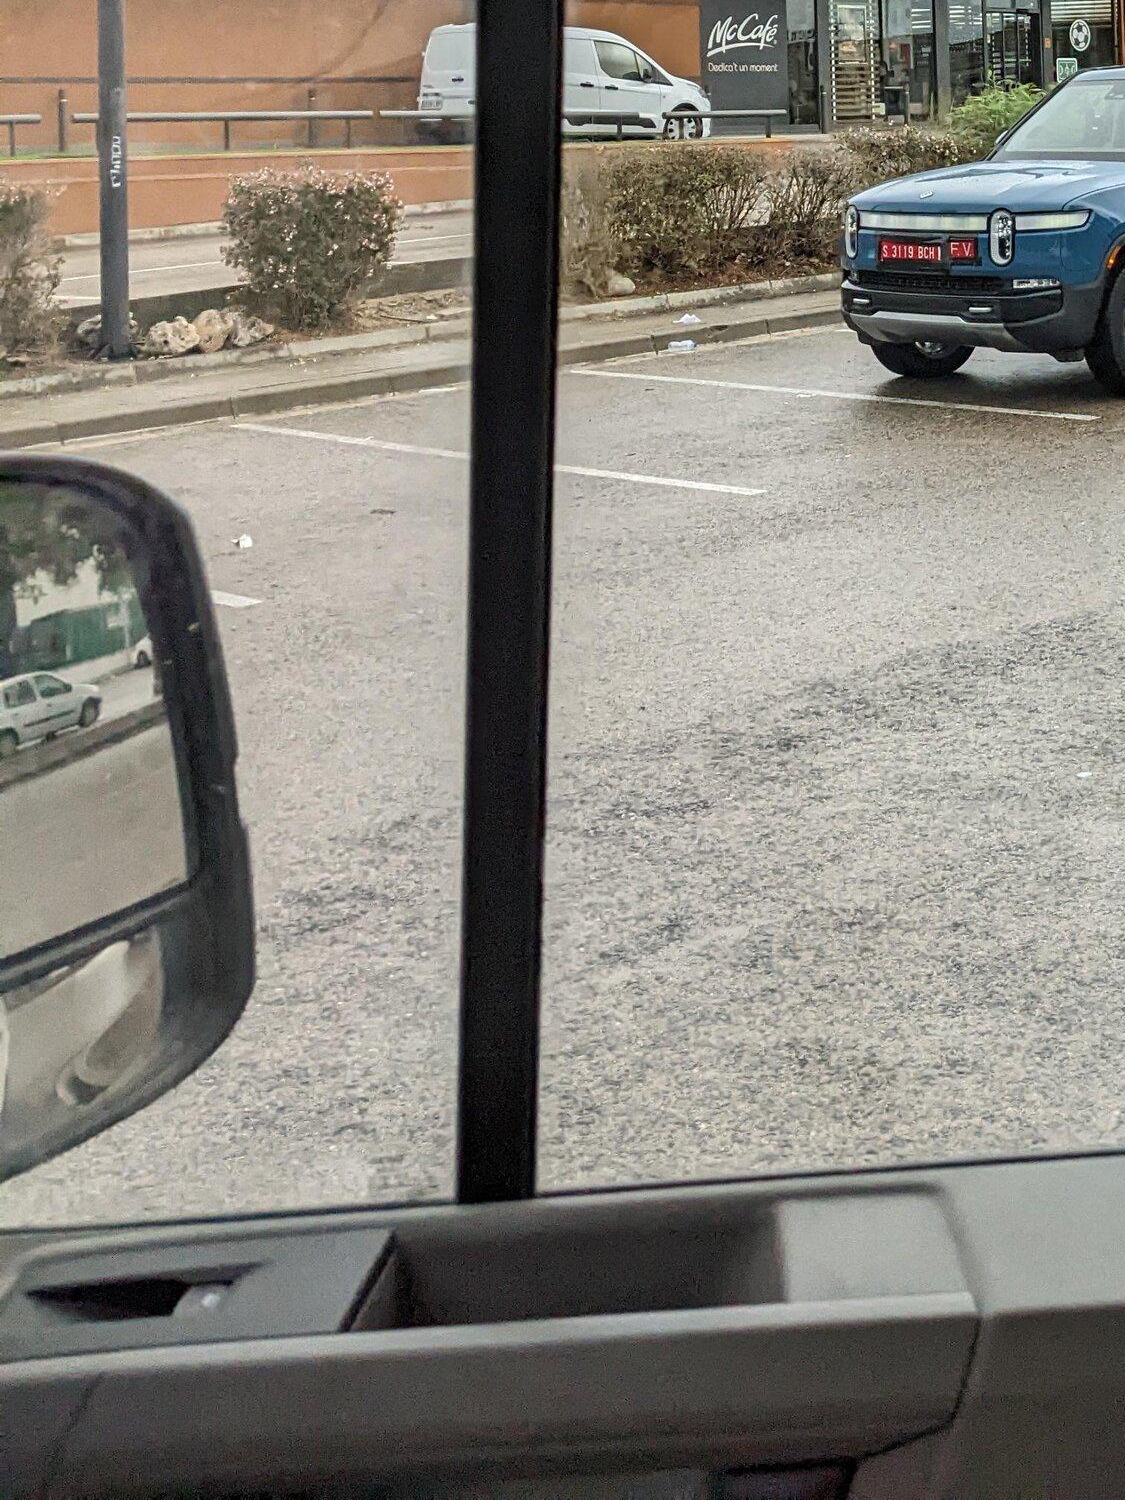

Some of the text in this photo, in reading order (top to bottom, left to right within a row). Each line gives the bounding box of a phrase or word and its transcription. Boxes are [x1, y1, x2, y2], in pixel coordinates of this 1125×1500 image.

[707, 13, 778, 54] McCafé
[739, 64, 748, 72] un
[749, 63, 778, 72] moment
[891, 245, 914, 258] 3119
[917, 246, 935, 259] BCH
